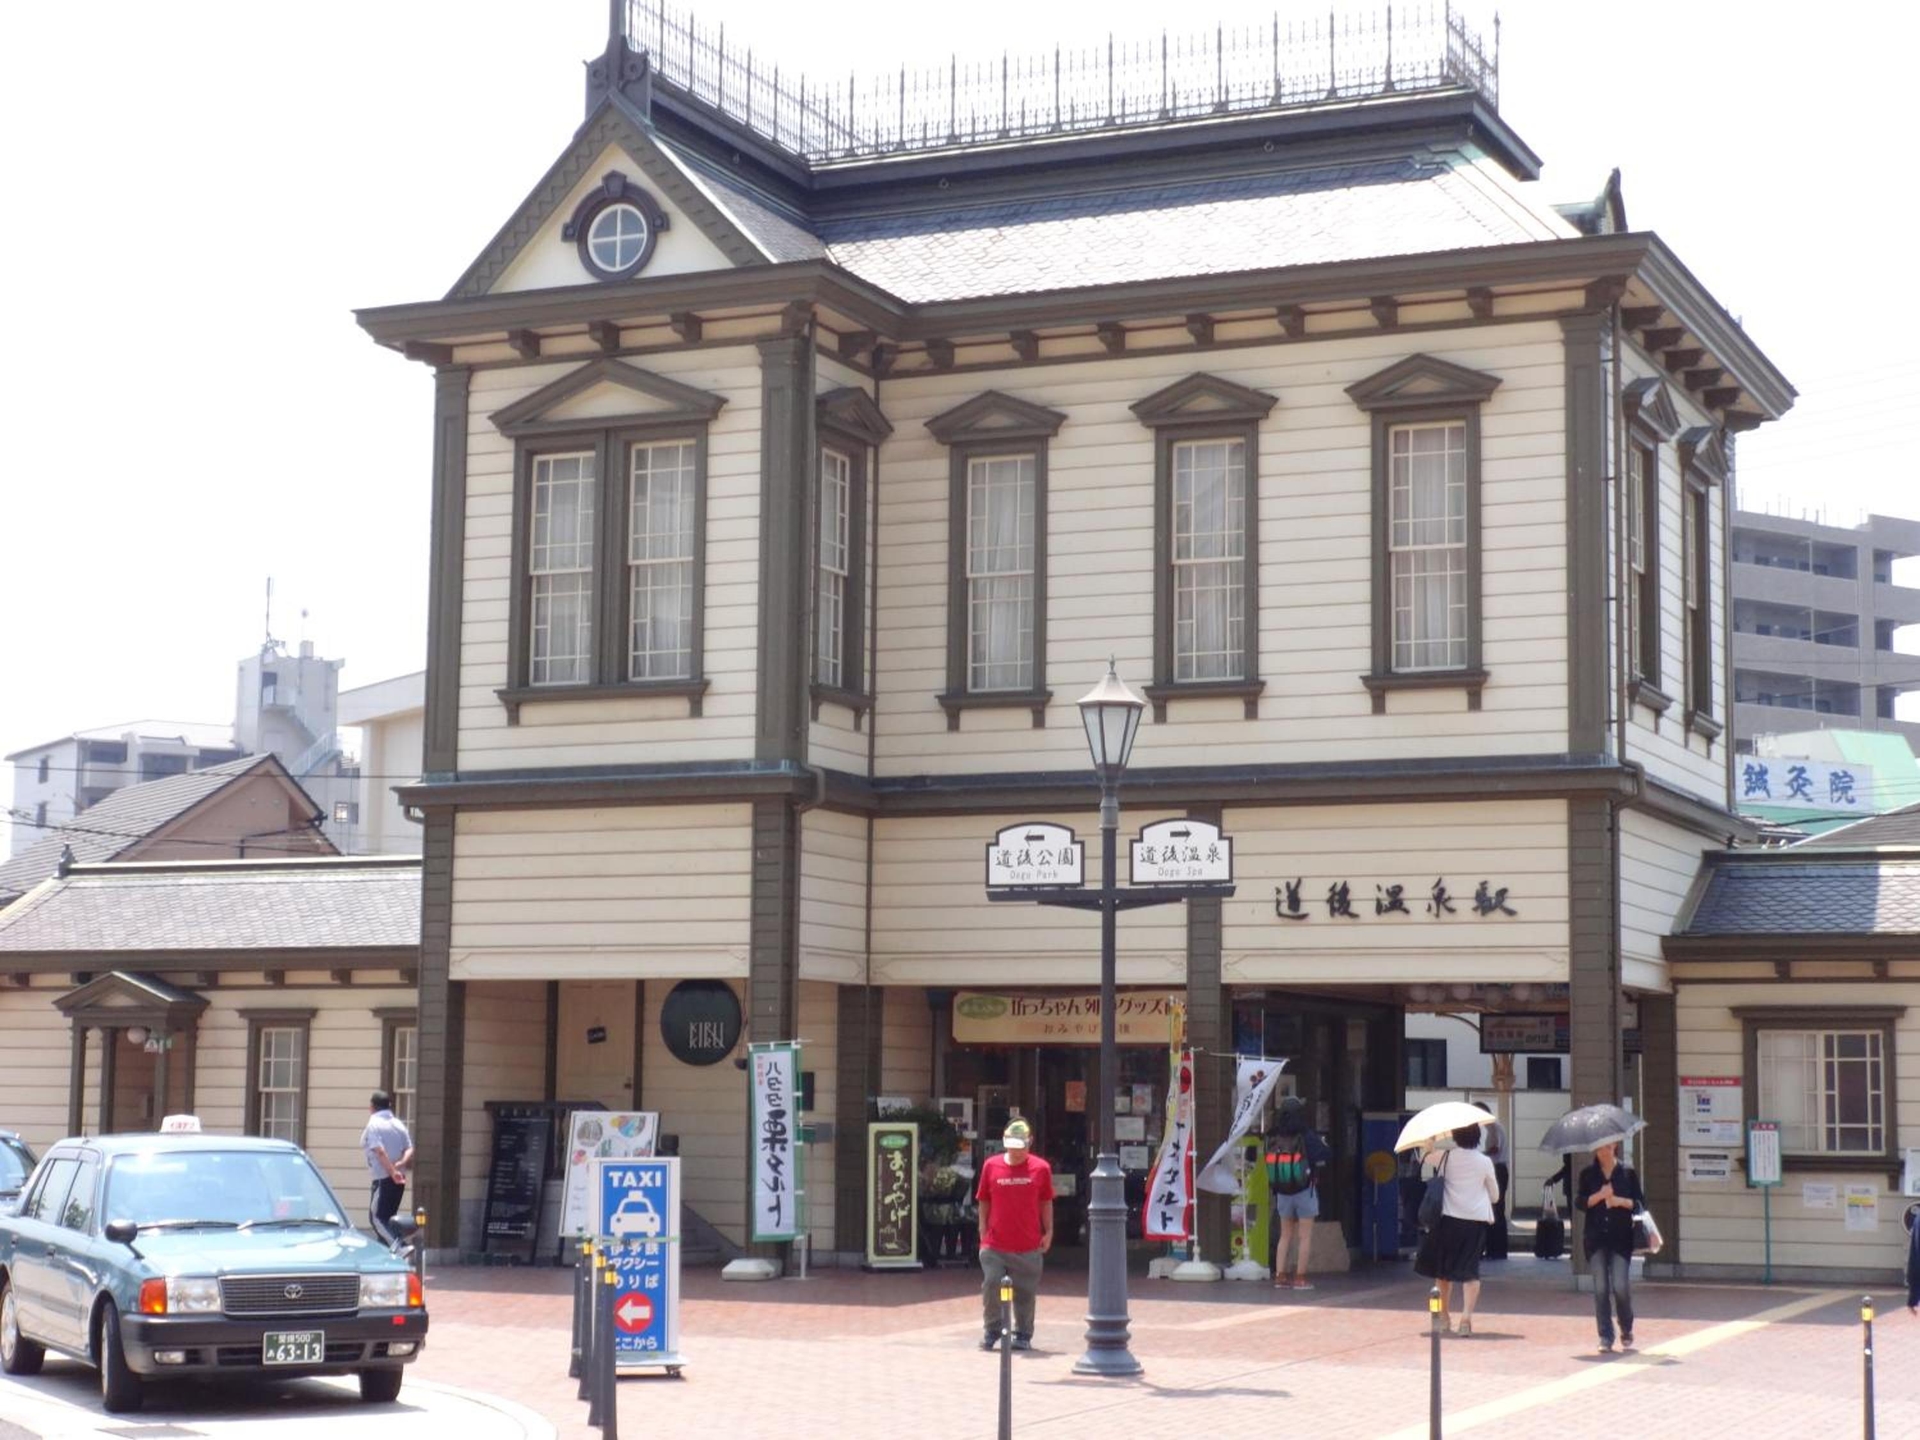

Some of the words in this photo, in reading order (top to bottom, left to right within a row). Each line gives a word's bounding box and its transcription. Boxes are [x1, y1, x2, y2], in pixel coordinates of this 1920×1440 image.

[1036, 869, 1059, 879] Park
[1187, 866, 1204, 877] Spa
[608, 1170, 662, 1188] TAXI
